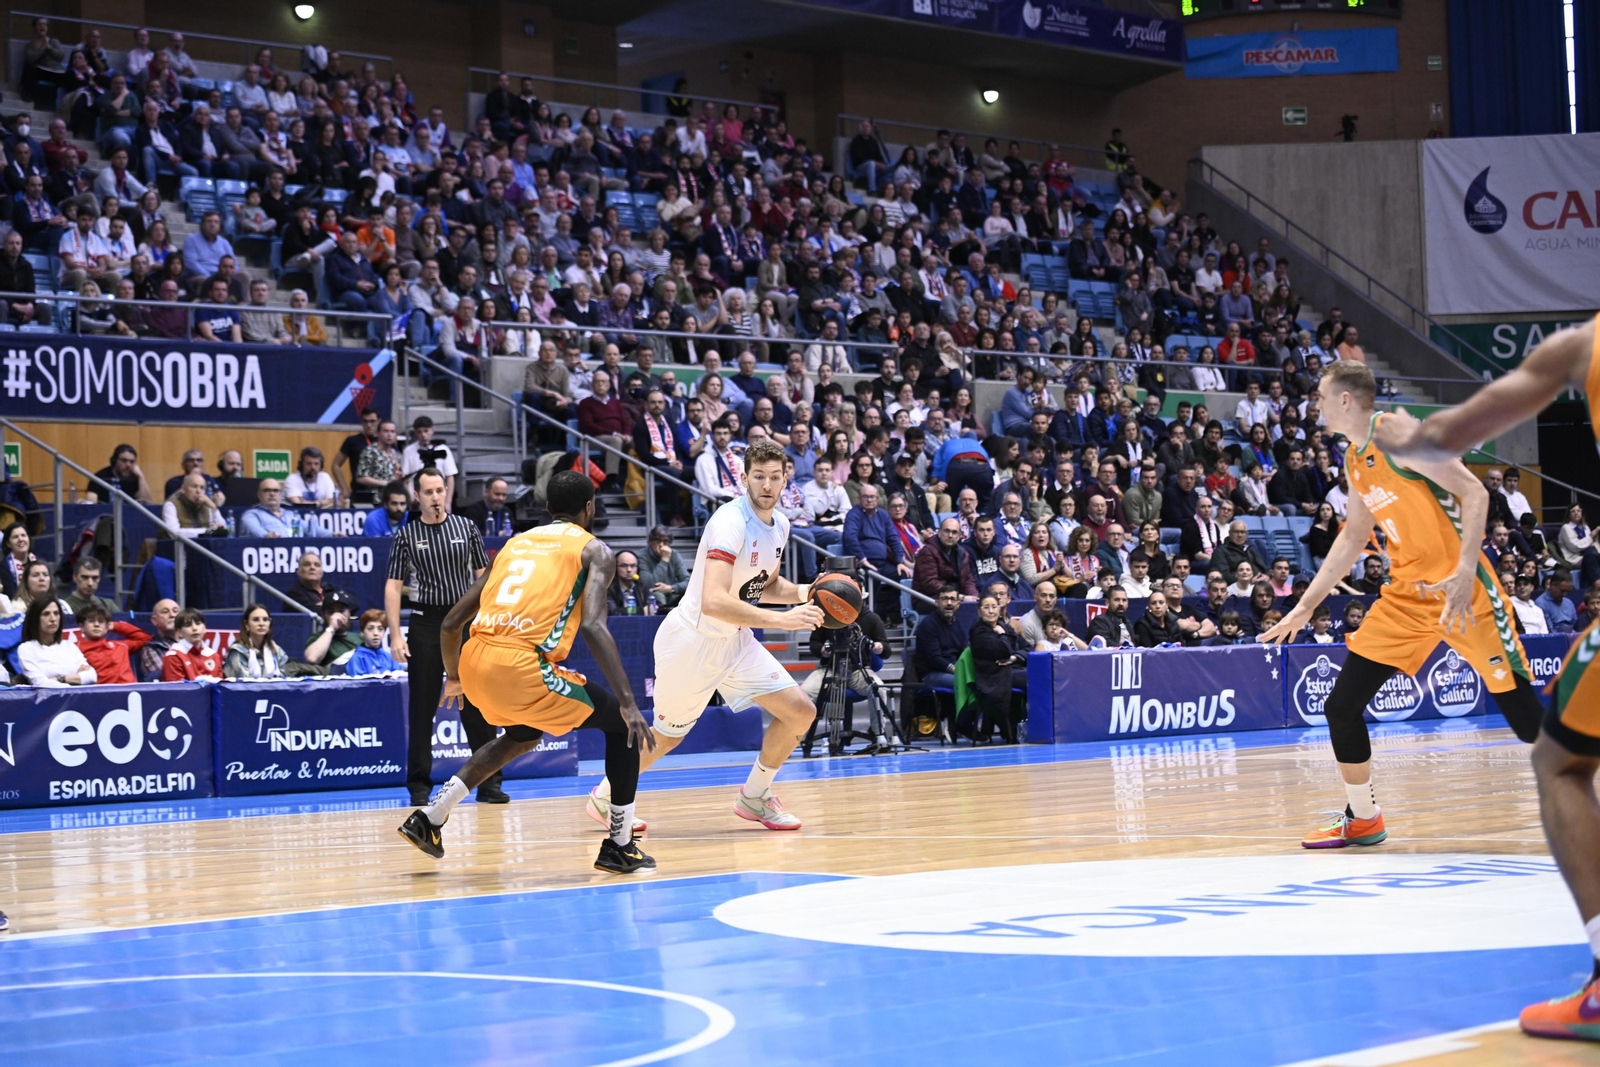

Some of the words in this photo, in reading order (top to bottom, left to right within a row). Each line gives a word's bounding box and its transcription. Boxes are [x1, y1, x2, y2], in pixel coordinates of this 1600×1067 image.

[1244, 48, 1338, 66] PESCAMAR
[1522, 189, 1600, 231] CA
[1525, 237, 1572, 251] AGUA
[3, 345, 266, 409] #SOMOSOBRA
[257, 459, 289, 473] SAIDA
[242, 546, 374, 574] OBRAOIRO
[496, 559, 536, 604] 2
[1434, 664, 1476, 686] Estrella
[1374, 690, 1416, 711] Galicia
[1438, 686, 1475, 705] Galicia
[270, 726, 383, 752] INDUPANEL
[226, 761, 292, 781] Puertas
[299, 760, 311, 780] &
[317, 757, 402, 777] Innovación
